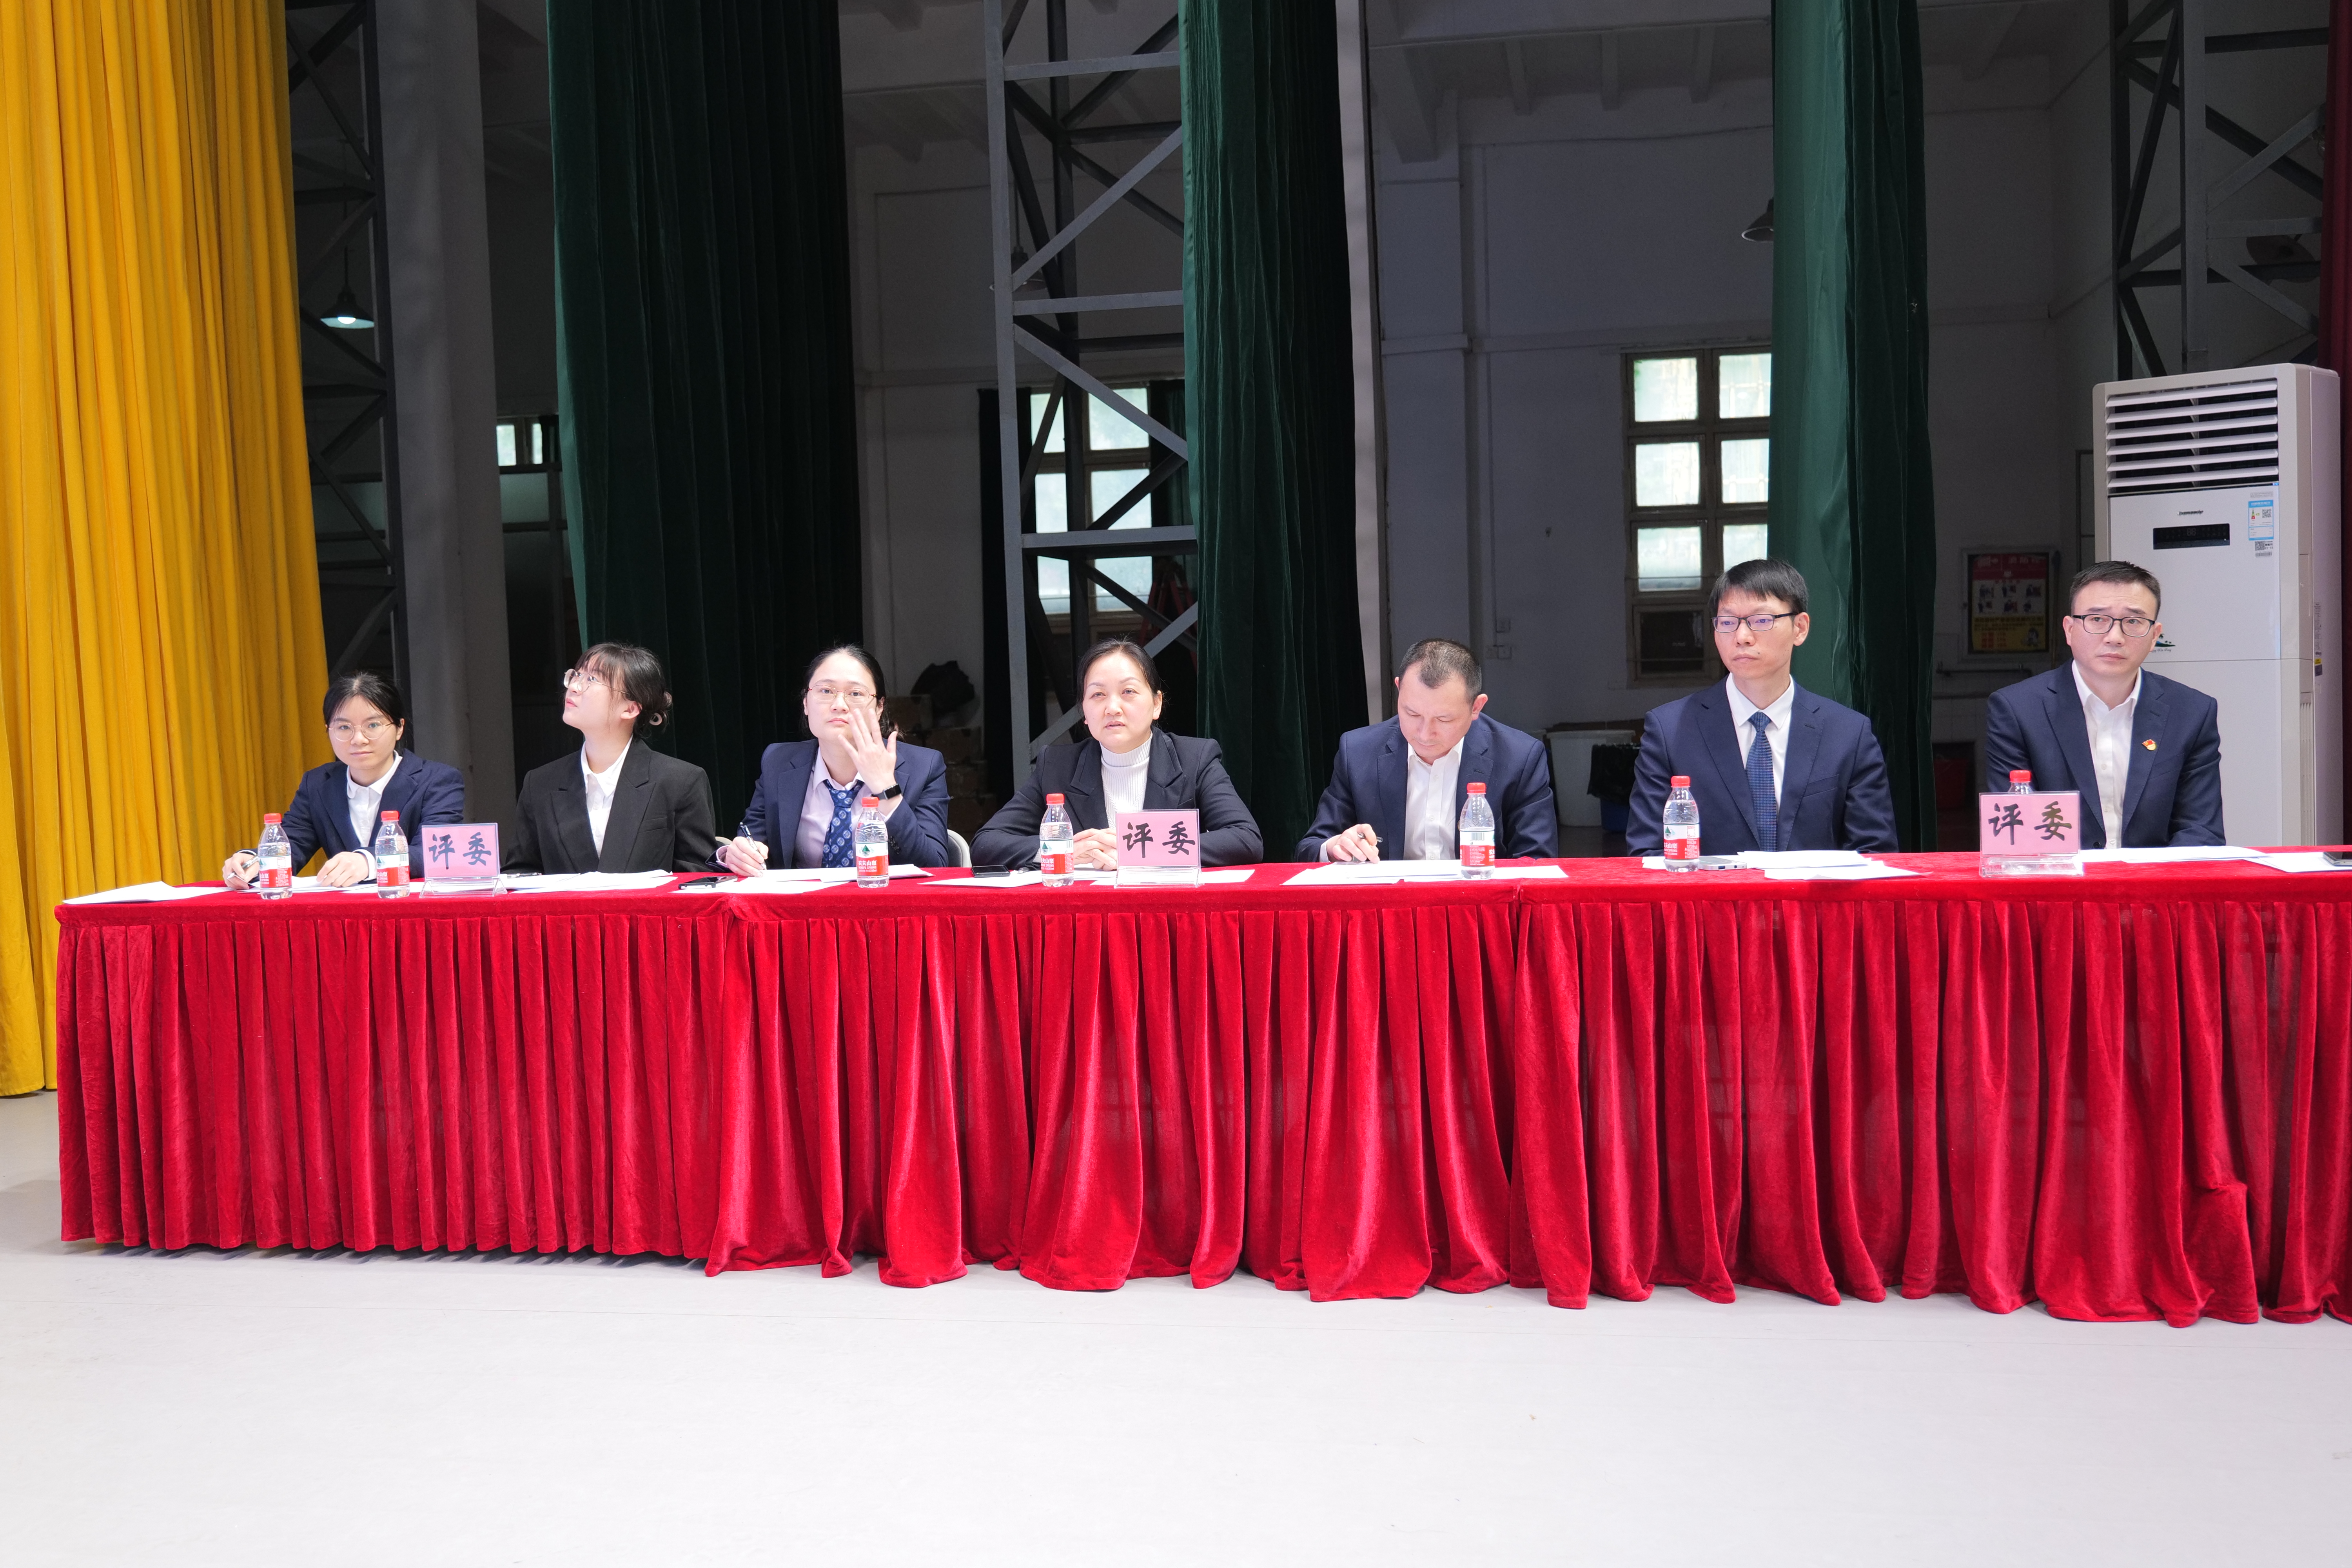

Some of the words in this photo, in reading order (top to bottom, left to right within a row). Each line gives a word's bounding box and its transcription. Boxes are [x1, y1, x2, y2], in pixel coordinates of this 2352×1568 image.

[1122, 821, 1196, 858] 评委
[1988, 801, 2072, 846] 评委
[429, 832, 492, 870] 评委
